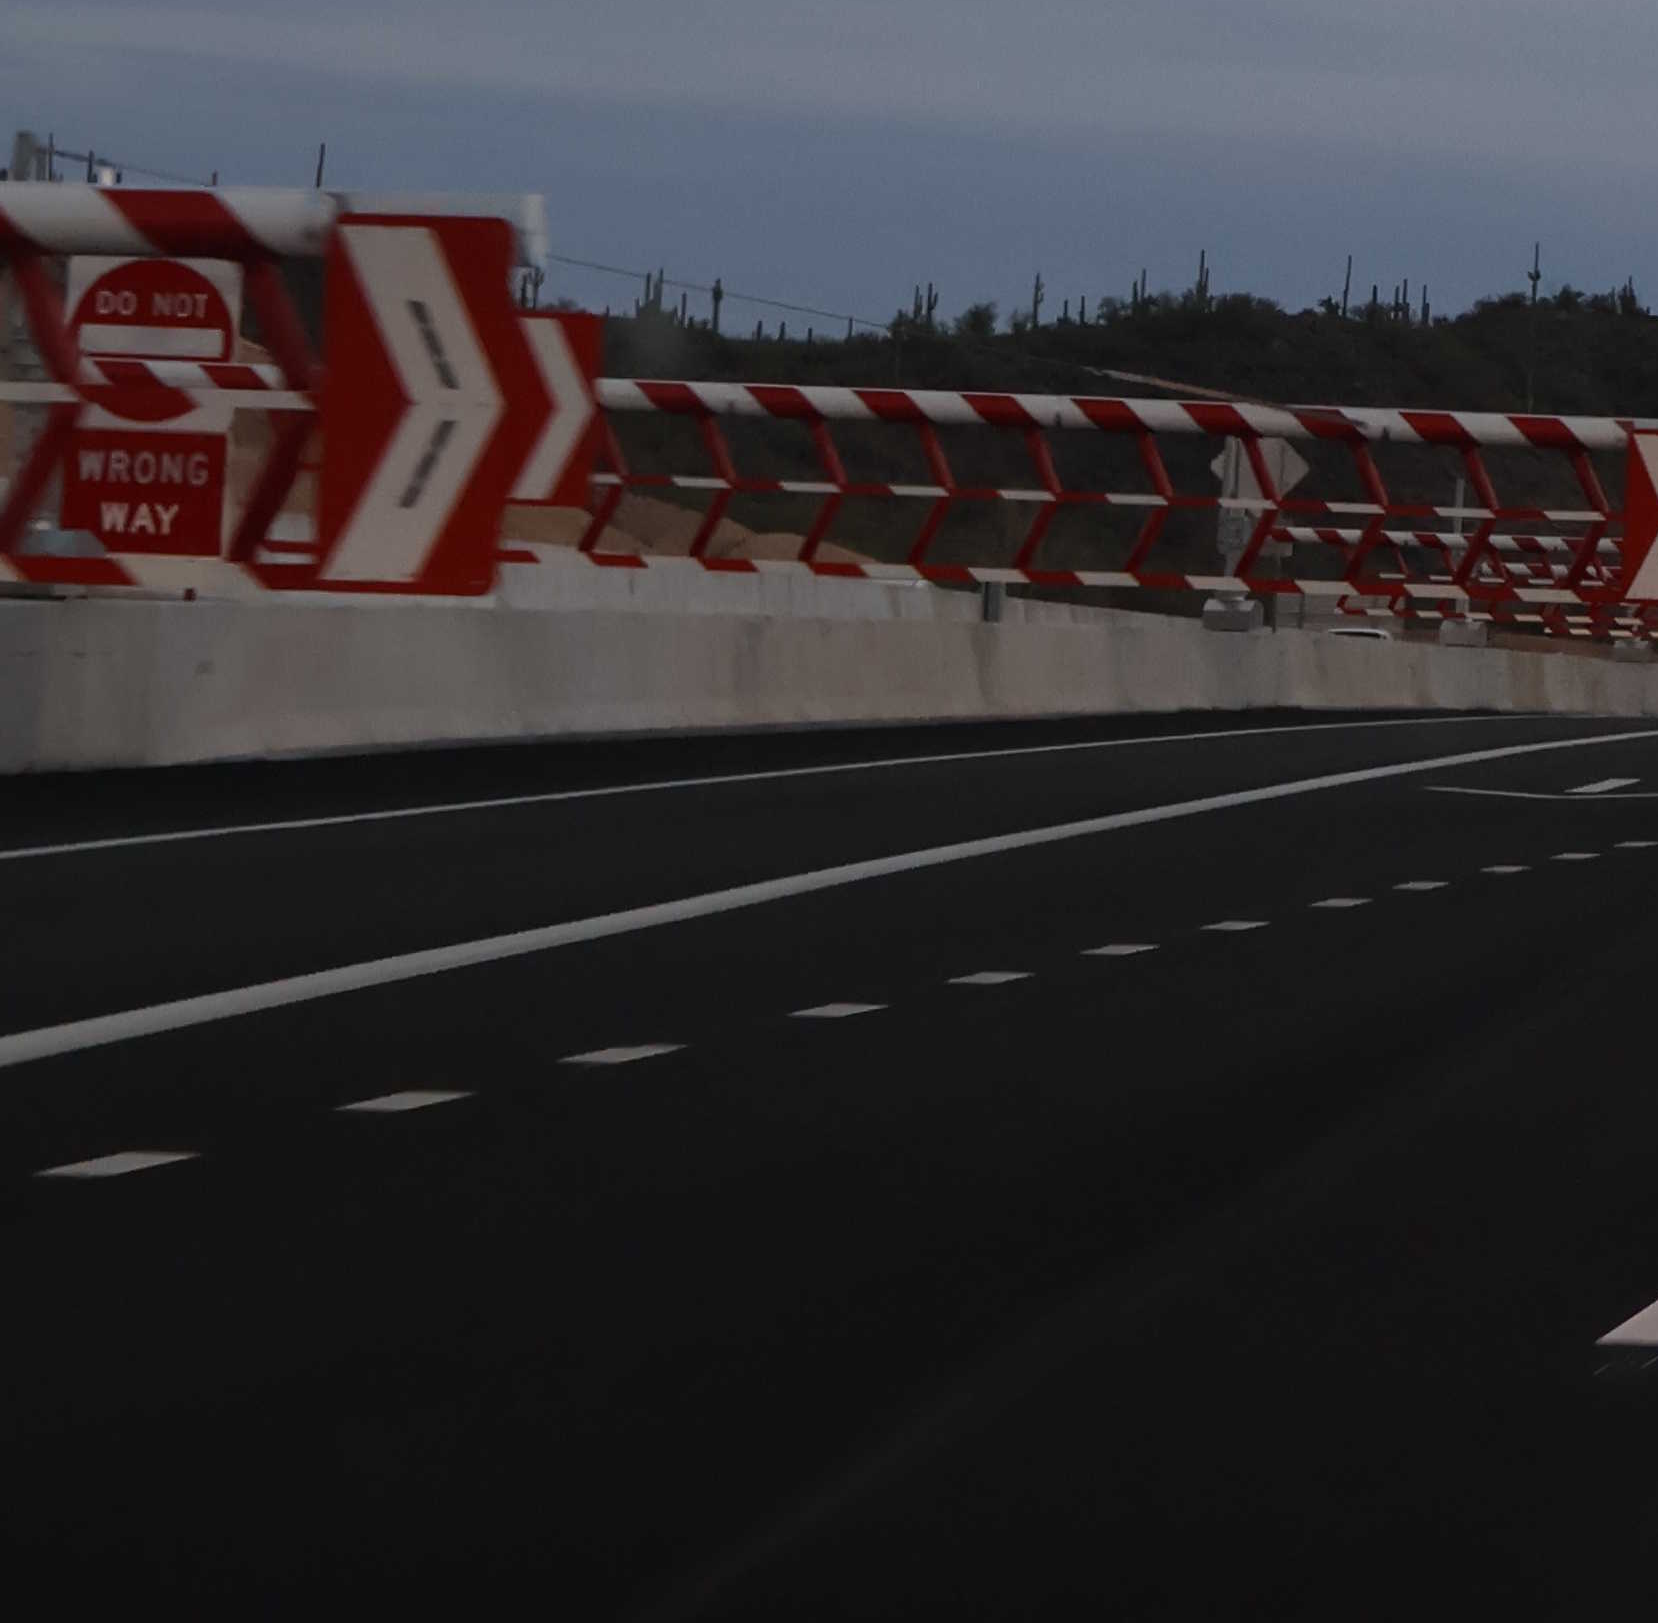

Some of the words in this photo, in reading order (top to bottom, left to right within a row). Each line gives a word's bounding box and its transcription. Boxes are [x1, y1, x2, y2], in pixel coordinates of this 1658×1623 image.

[95, 290, 137, 316] DO
[153, 292, 208, 318] NOT
[78, 448, 209, 485] WRONG
[100, 501, 179, 535] WAY
